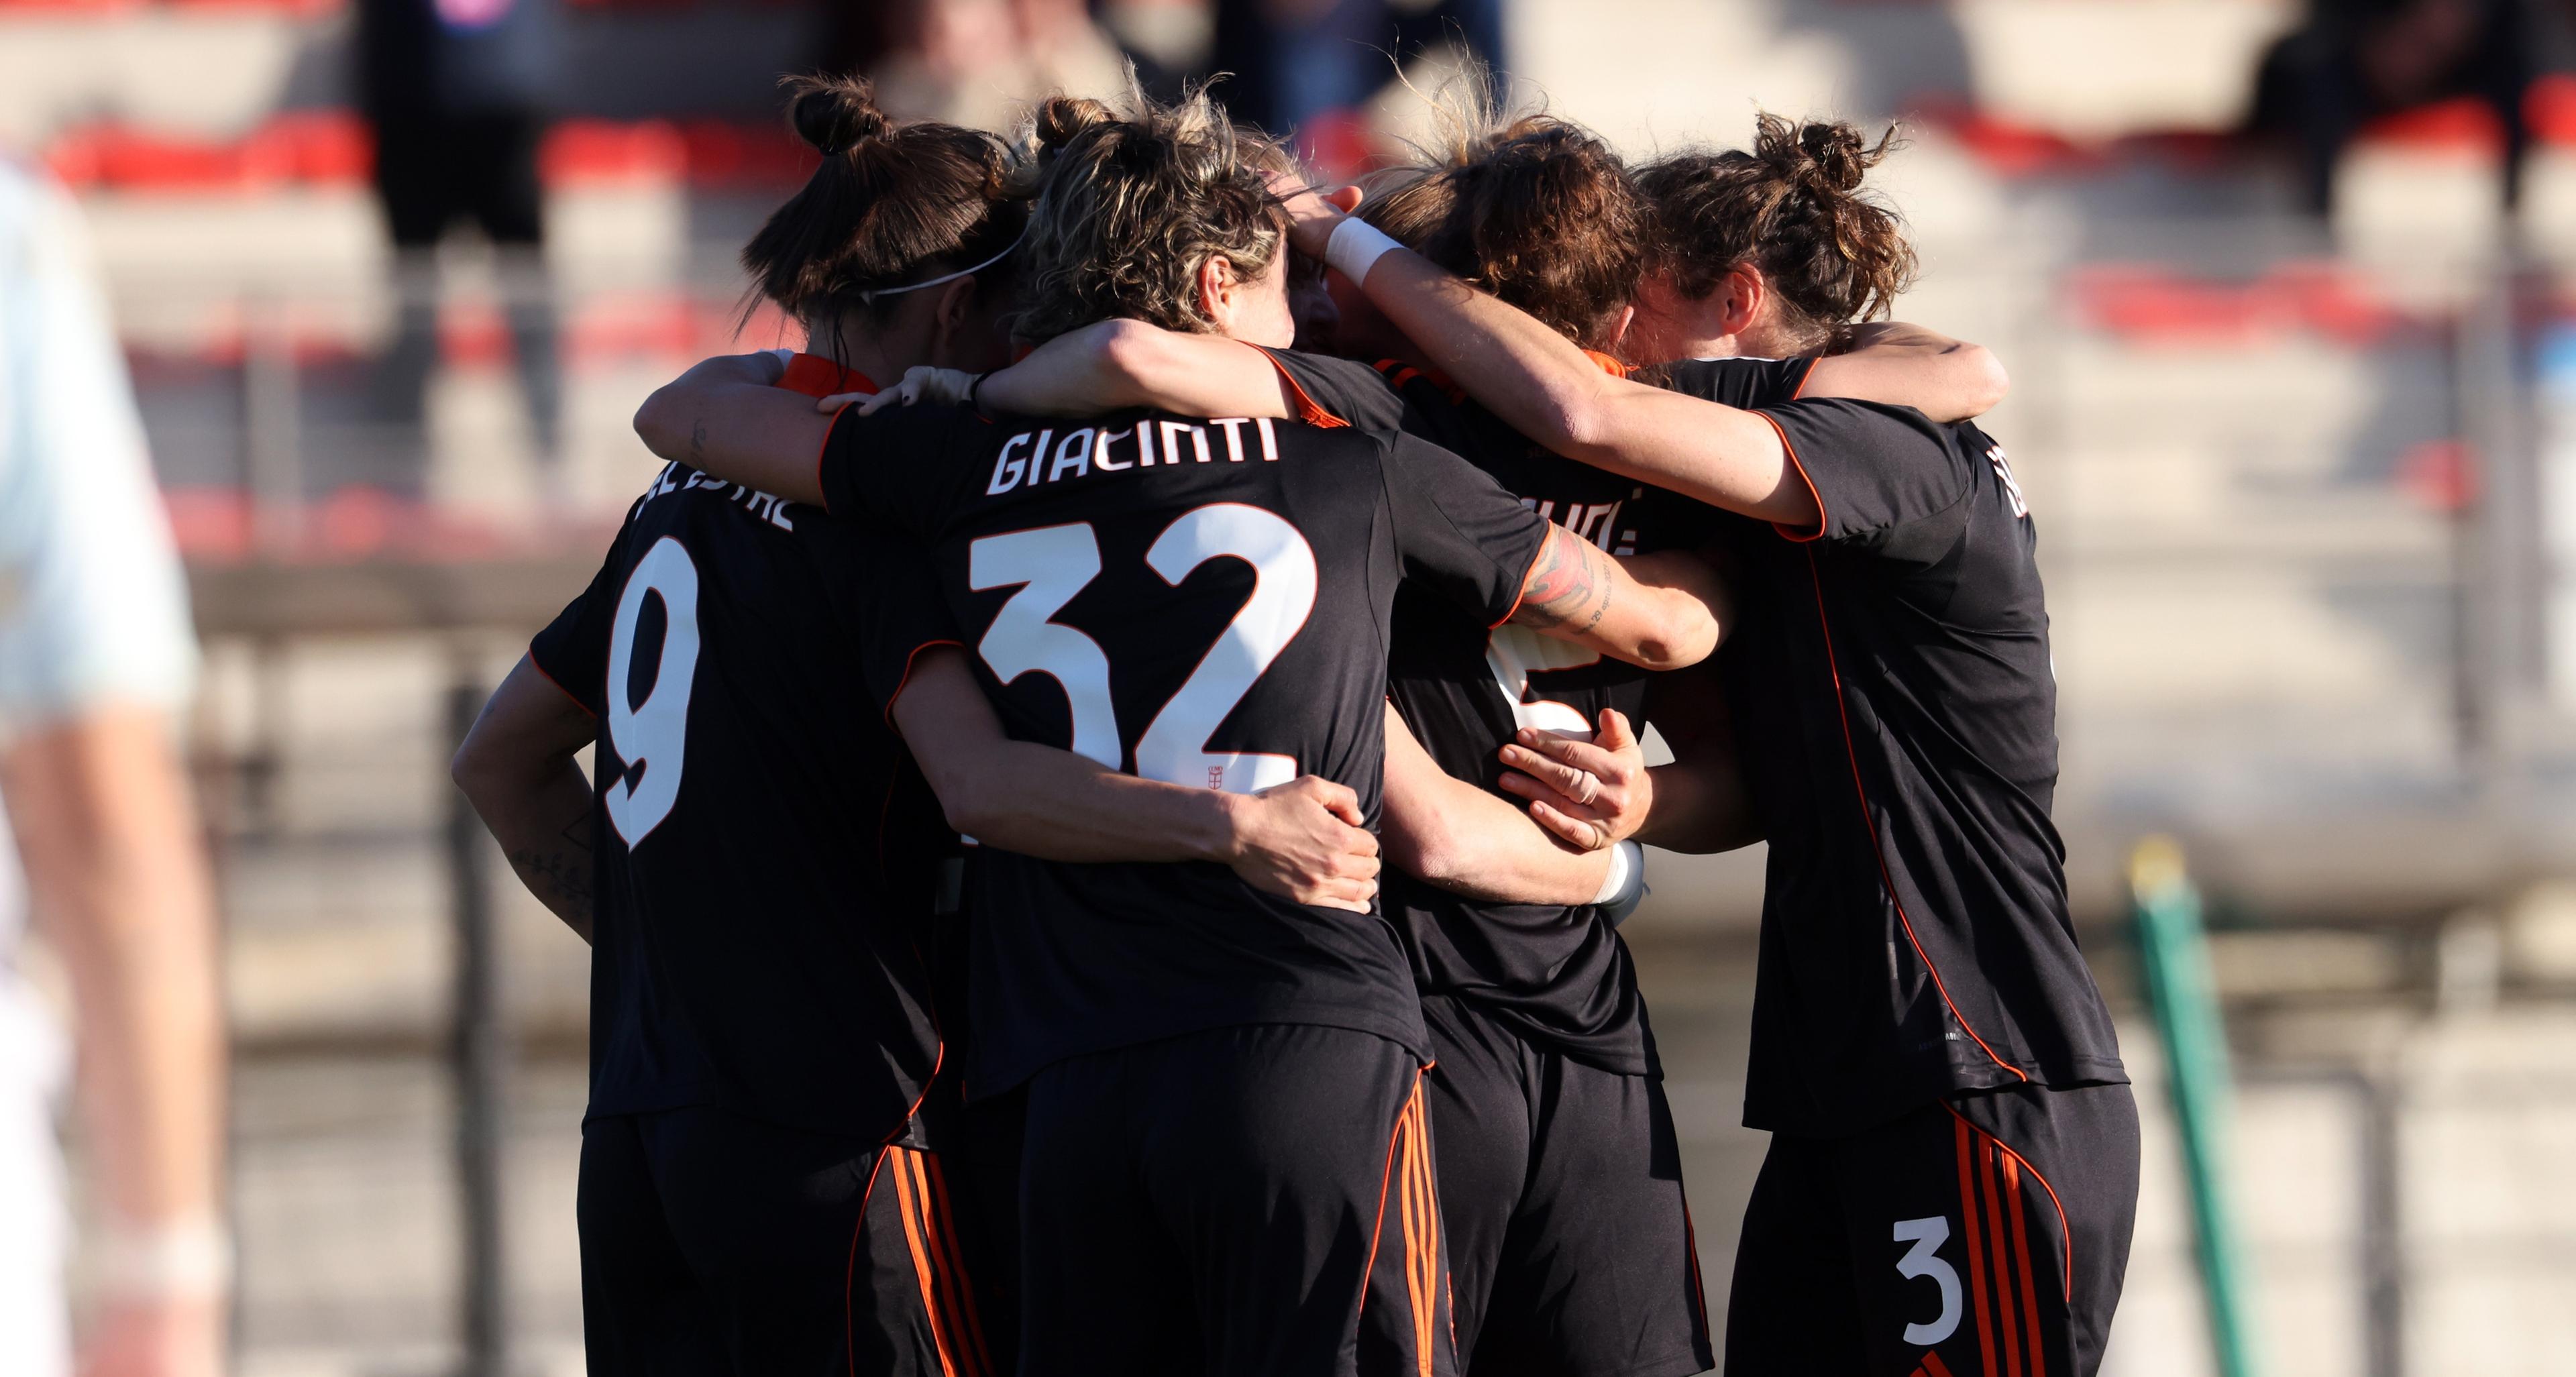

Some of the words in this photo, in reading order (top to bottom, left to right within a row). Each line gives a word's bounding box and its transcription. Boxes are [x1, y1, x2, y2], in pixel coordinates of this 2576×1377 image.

[986, 417, 1279, 496] GIACINTI
[605, 535, 700, 854] 9
[961, 502, 1318, 846] 32
[1893, 1215, 1963, 1345] 3
